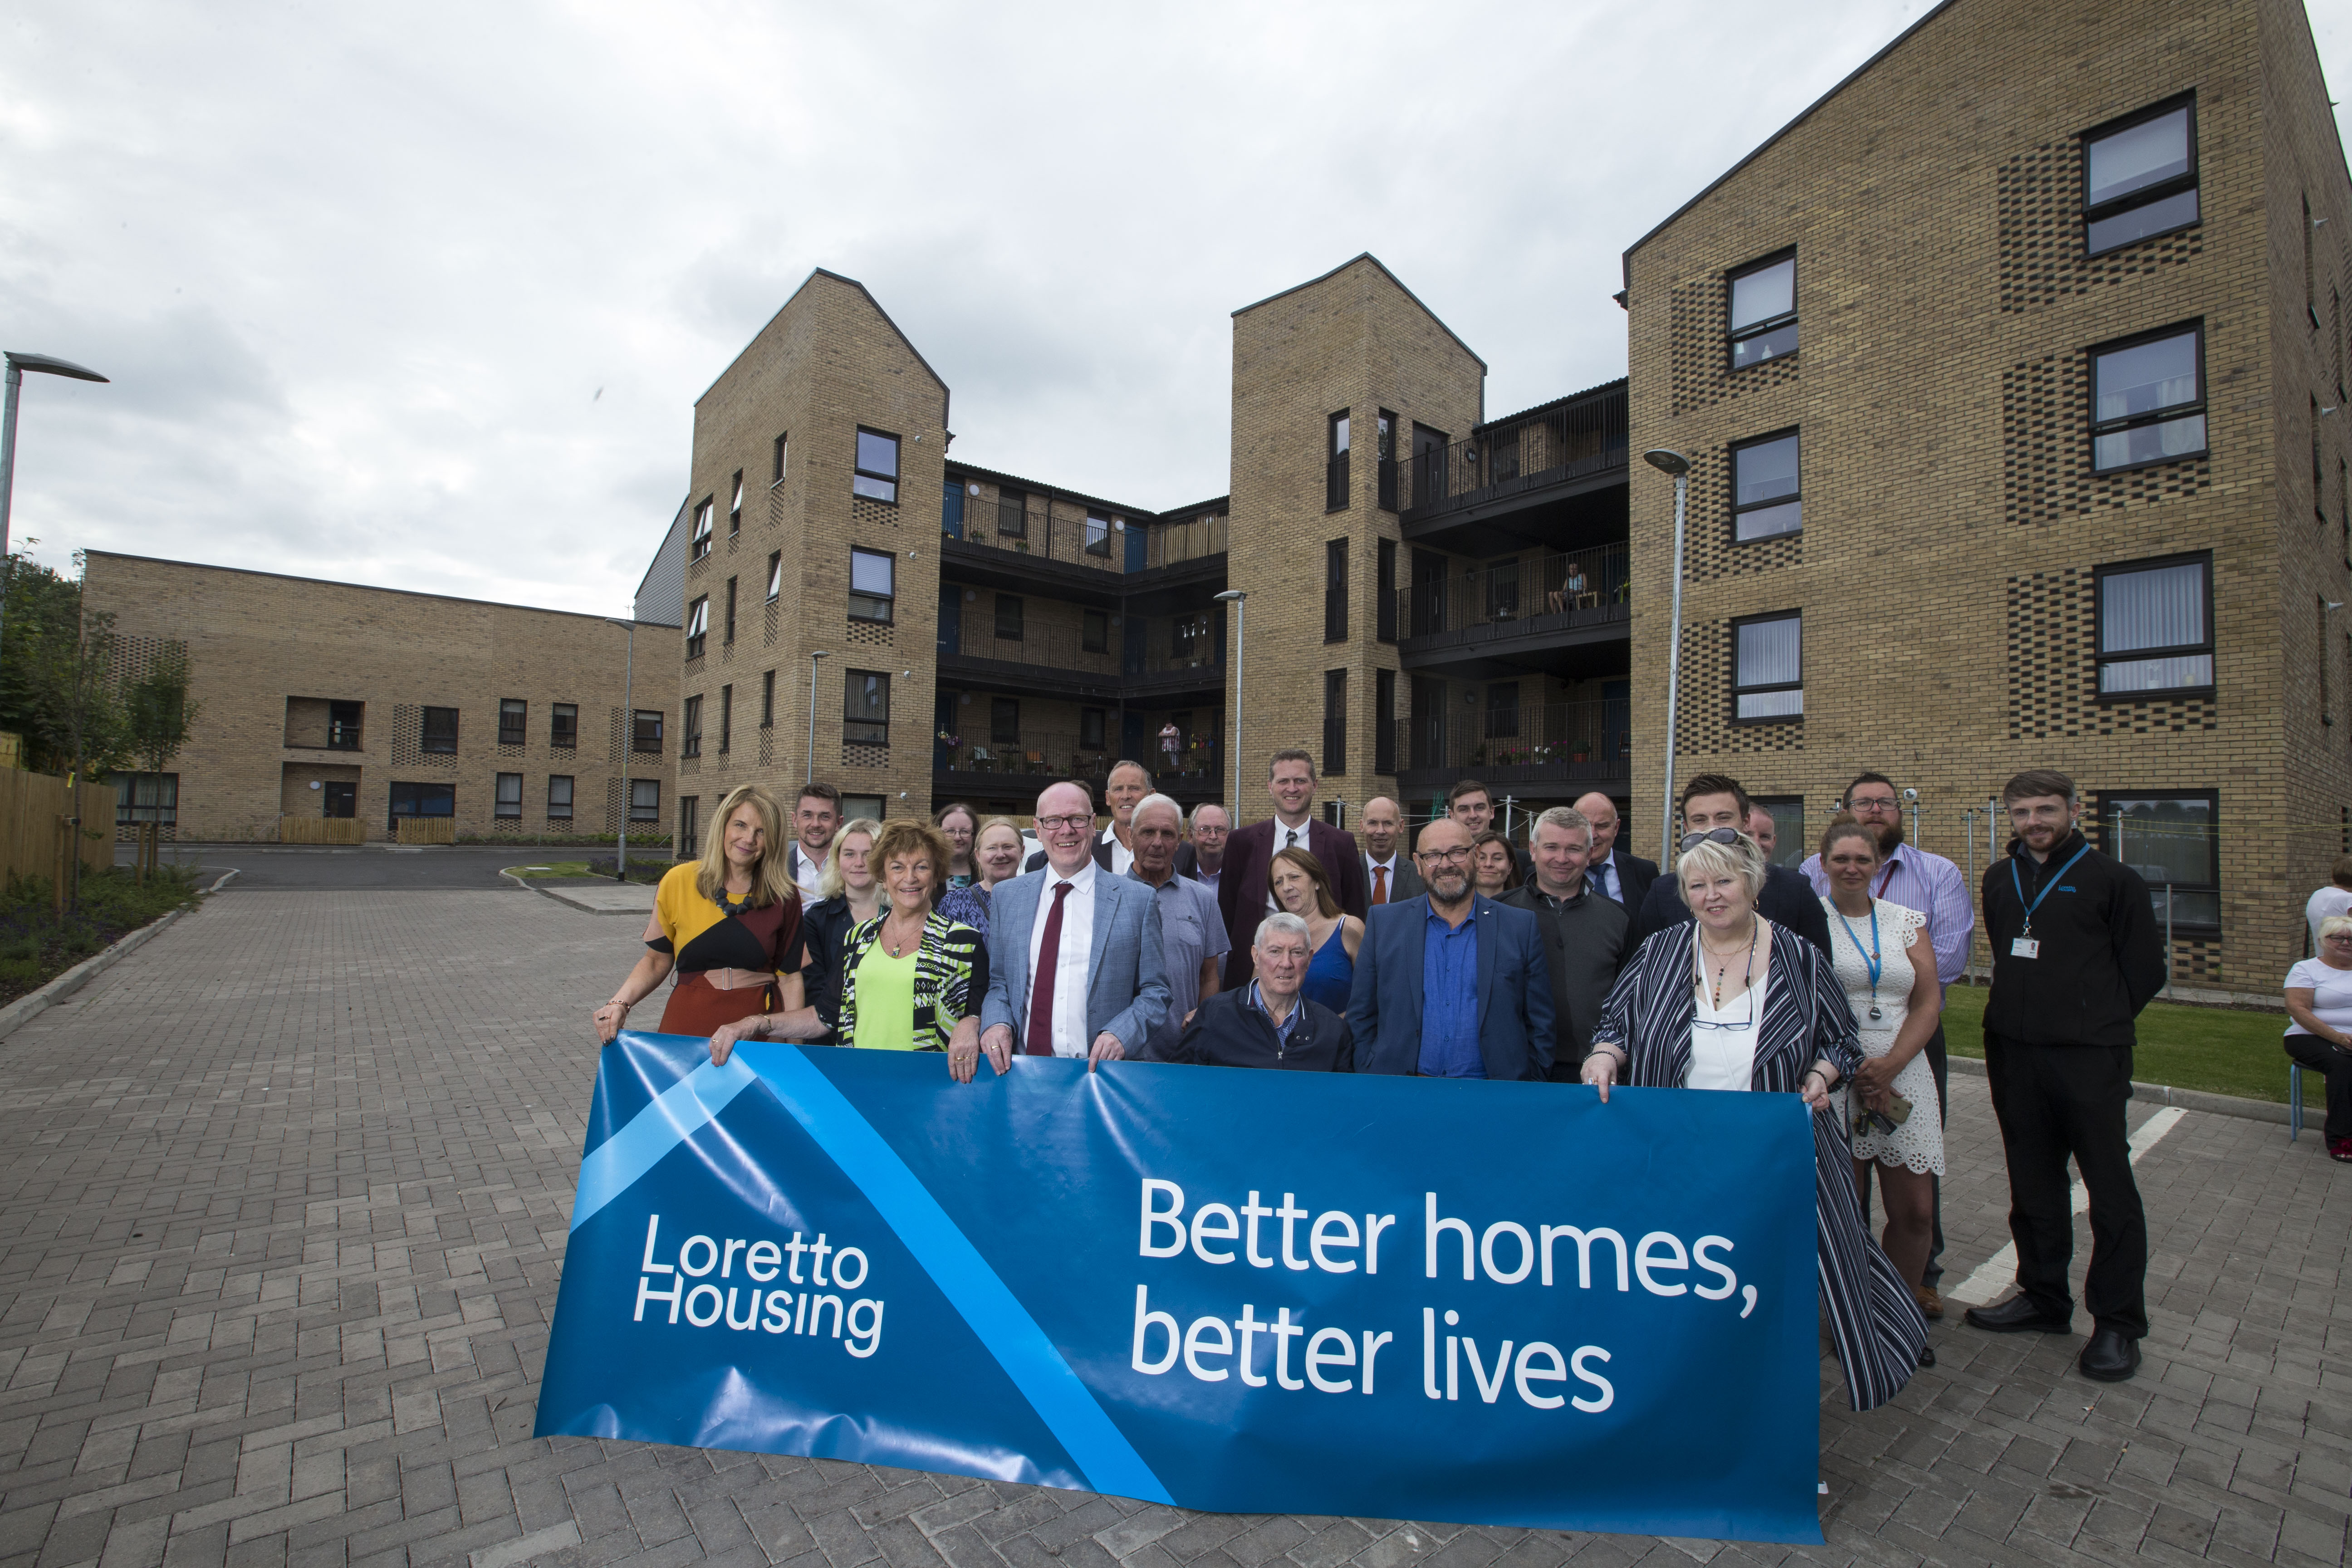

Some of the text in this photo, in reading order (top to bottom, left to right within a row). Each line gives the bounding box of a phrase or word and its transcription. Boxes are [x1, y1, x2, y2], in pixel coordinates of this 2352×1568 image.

[642, 1214, 868, 1289] Loretto
[1140, 1179, 1757, 1318] Better homes,
[634, 1271, 884, 1358] Housing
[1132, 1284, 1614, 1412] better lives
